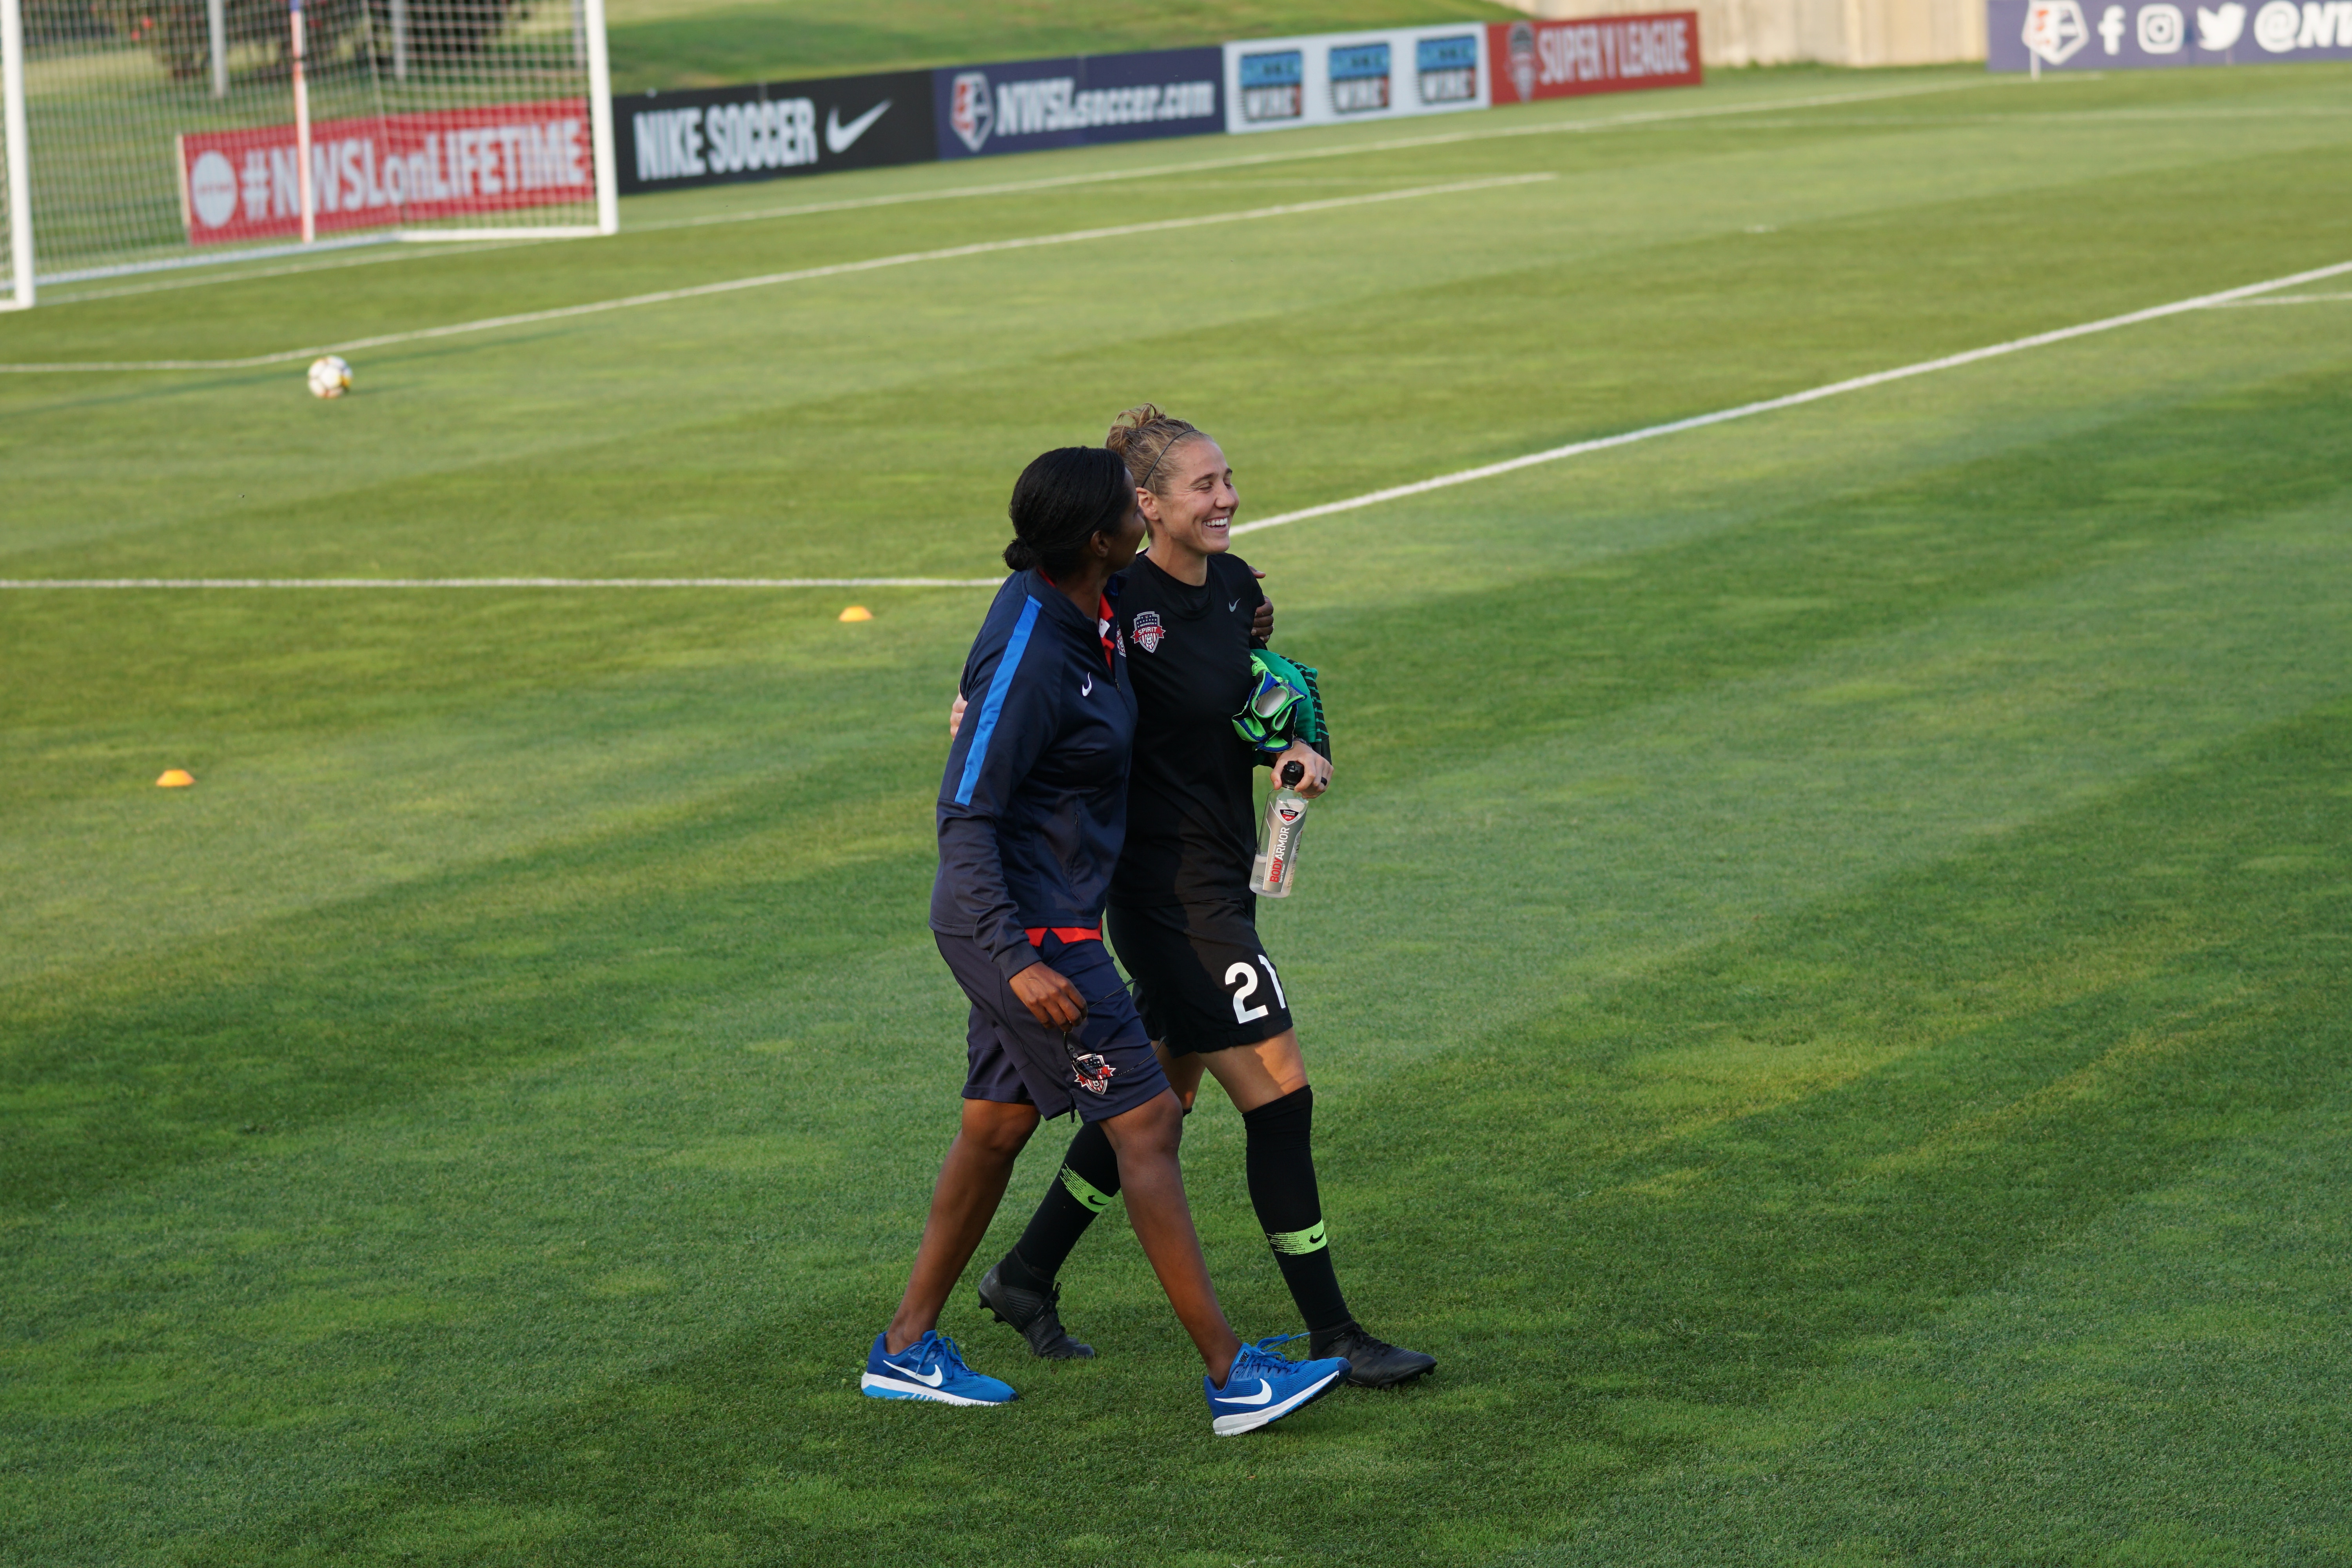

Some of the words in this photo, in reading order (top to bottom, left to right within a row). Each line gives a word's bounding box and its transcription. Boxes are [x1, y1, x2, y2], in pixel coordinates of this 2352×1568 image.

[1537, 24, 1601, 85] SUPER
[1617, 18, 1690, 78] LEAGUE
[242, 119, 585, 221] #NWSLonLIFETIME
[633, 107, 706, 181] NIKE
[706, 96, 818, 174] SOCCER
[1138, 627, 1157, 635] SPIRIT
[1270, 827, 1290, 882] BODYARMOR
[1225, 954, 1287, 1024] 21
